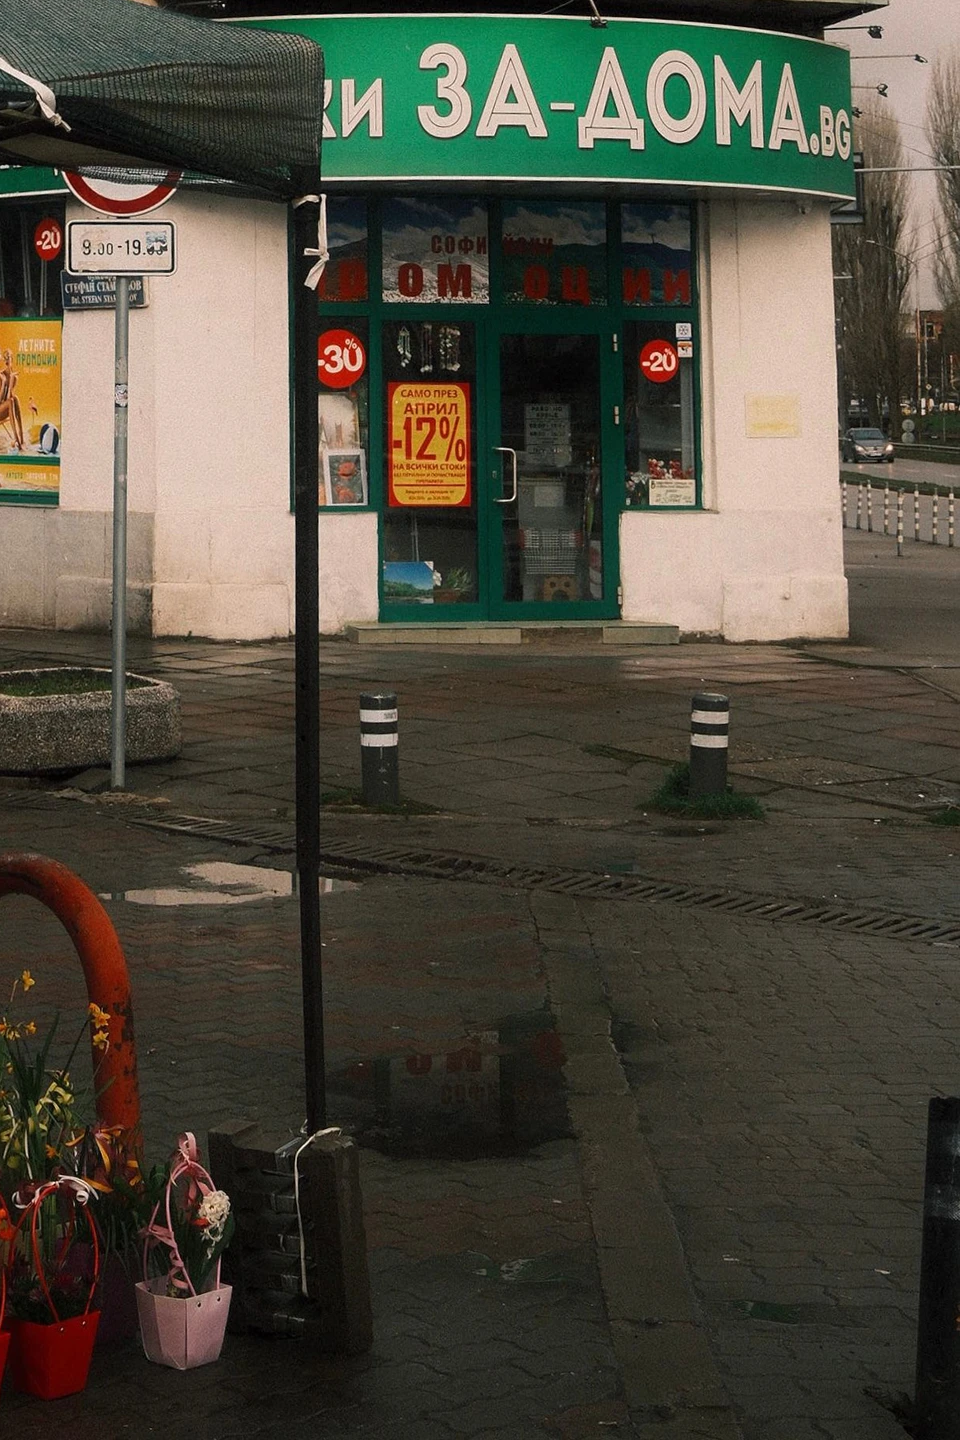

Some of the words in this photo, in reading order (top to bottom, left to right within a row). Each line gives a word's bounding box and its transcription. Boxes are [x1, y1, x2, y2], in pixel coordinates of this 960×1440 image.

[18, 339, 56, 353] ЛЕТНИТЕ
[16, 353, 58, 367] ПРОМОЦИИ
[401, 389, 431, 398] САМО
[434, 390, 458, 398] ПРЕЗ
[403, 403, 458, 415] АПРИЛ
[393, 416, 466, 462] -12%
